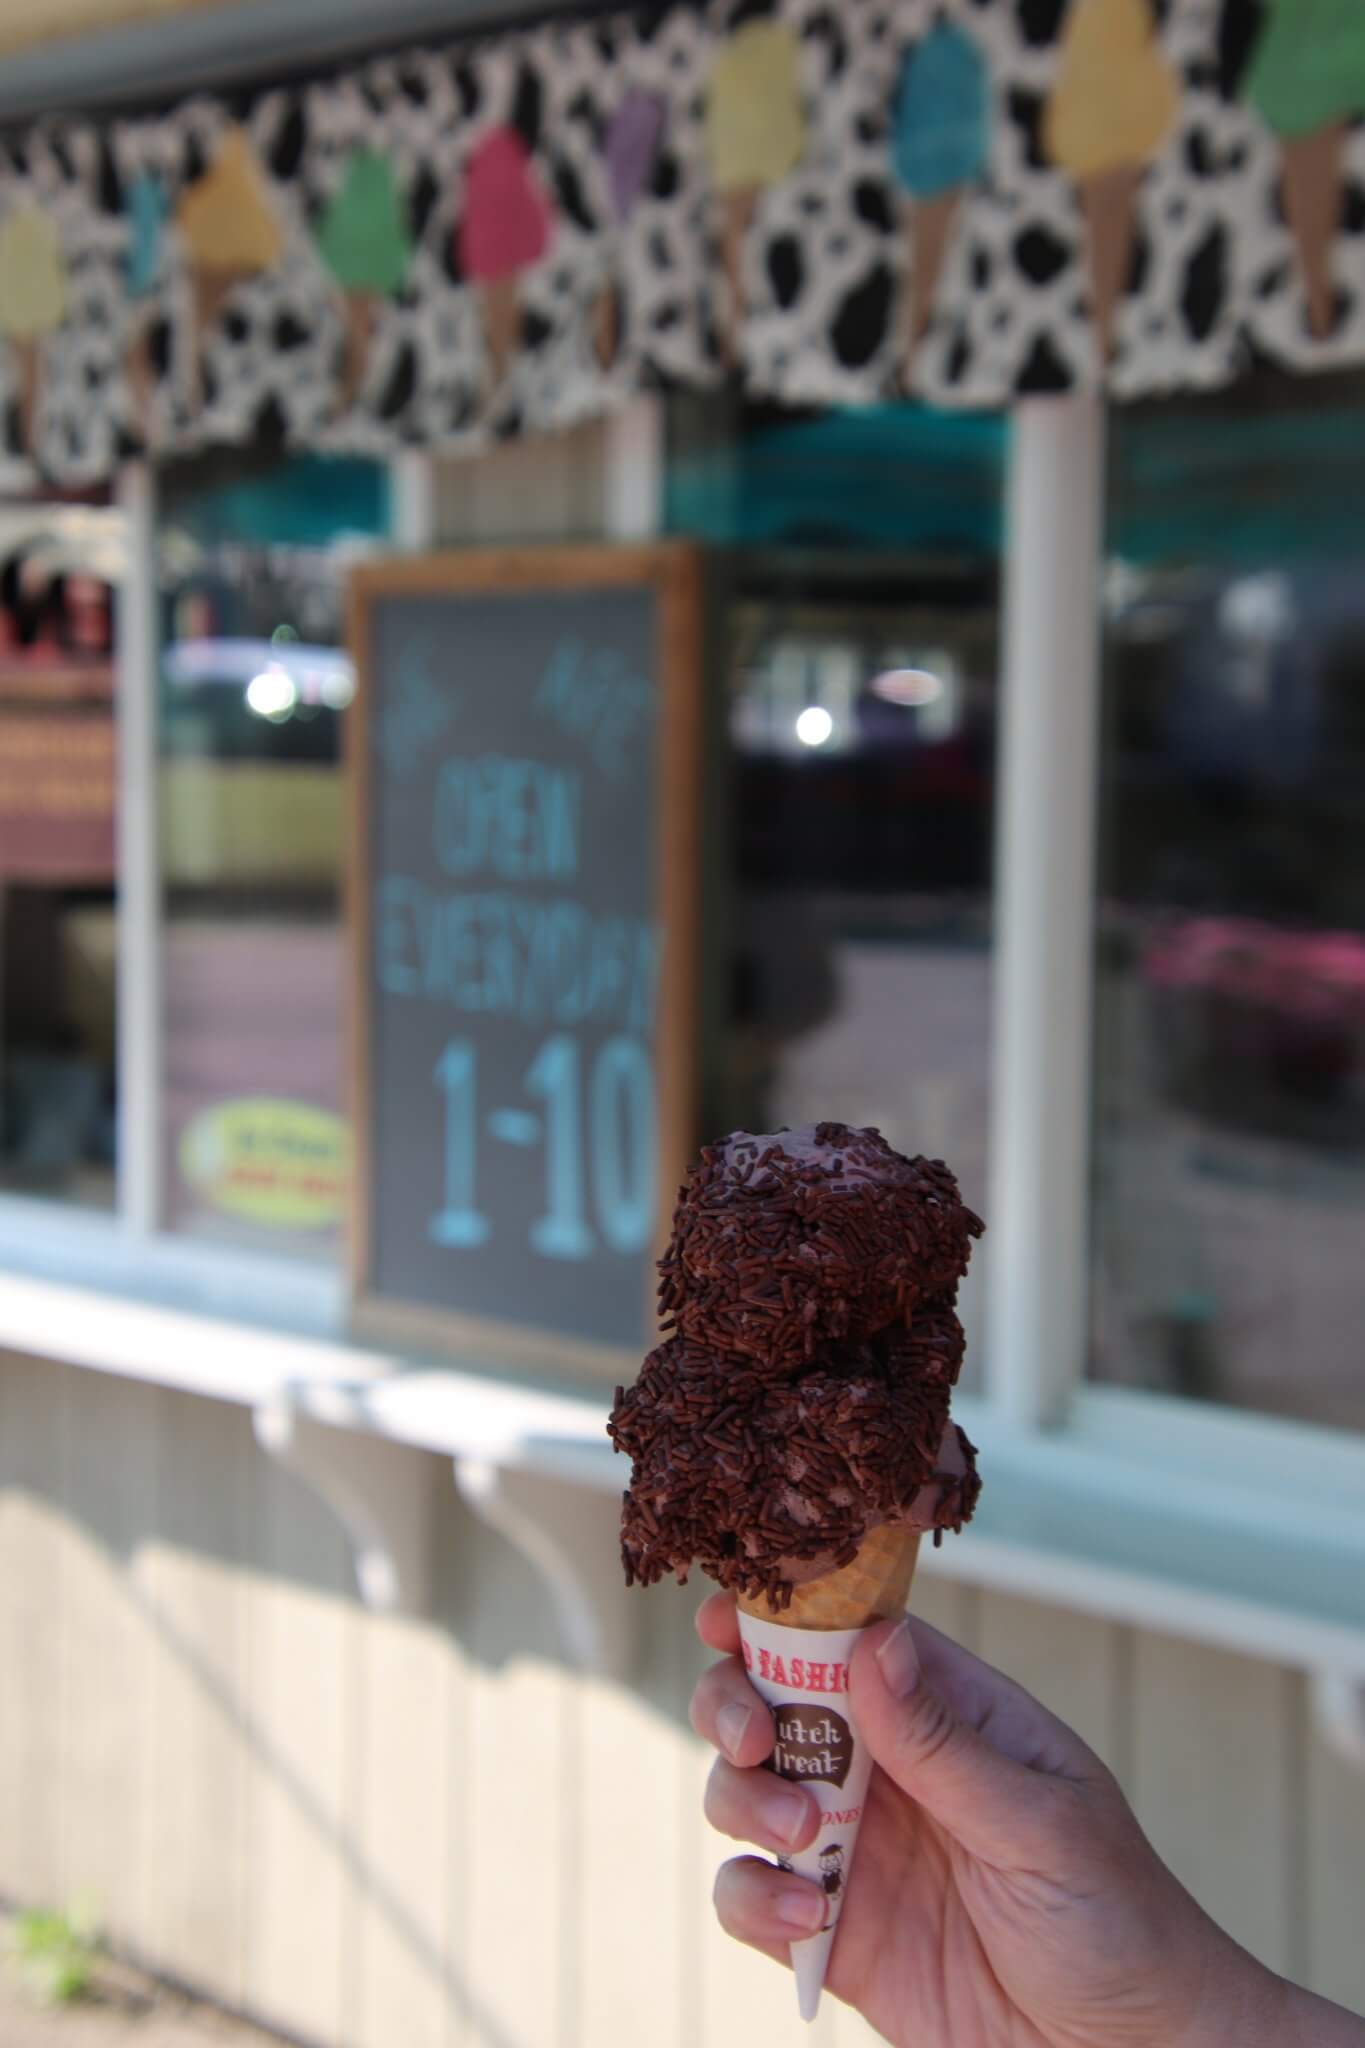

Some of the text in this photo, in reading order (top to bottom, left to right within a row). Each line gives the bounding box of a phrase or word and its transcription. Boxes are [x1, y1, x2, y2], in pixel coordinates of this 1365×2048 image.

[433, 755, 582, 883] OPEN
[428, 1034, 658, 1261] 1-10
[758, 1648, 849, 1693] FASHI
[778, 1718, 842, 1745] utch
[820, 1806, 862, 1826] ONES
